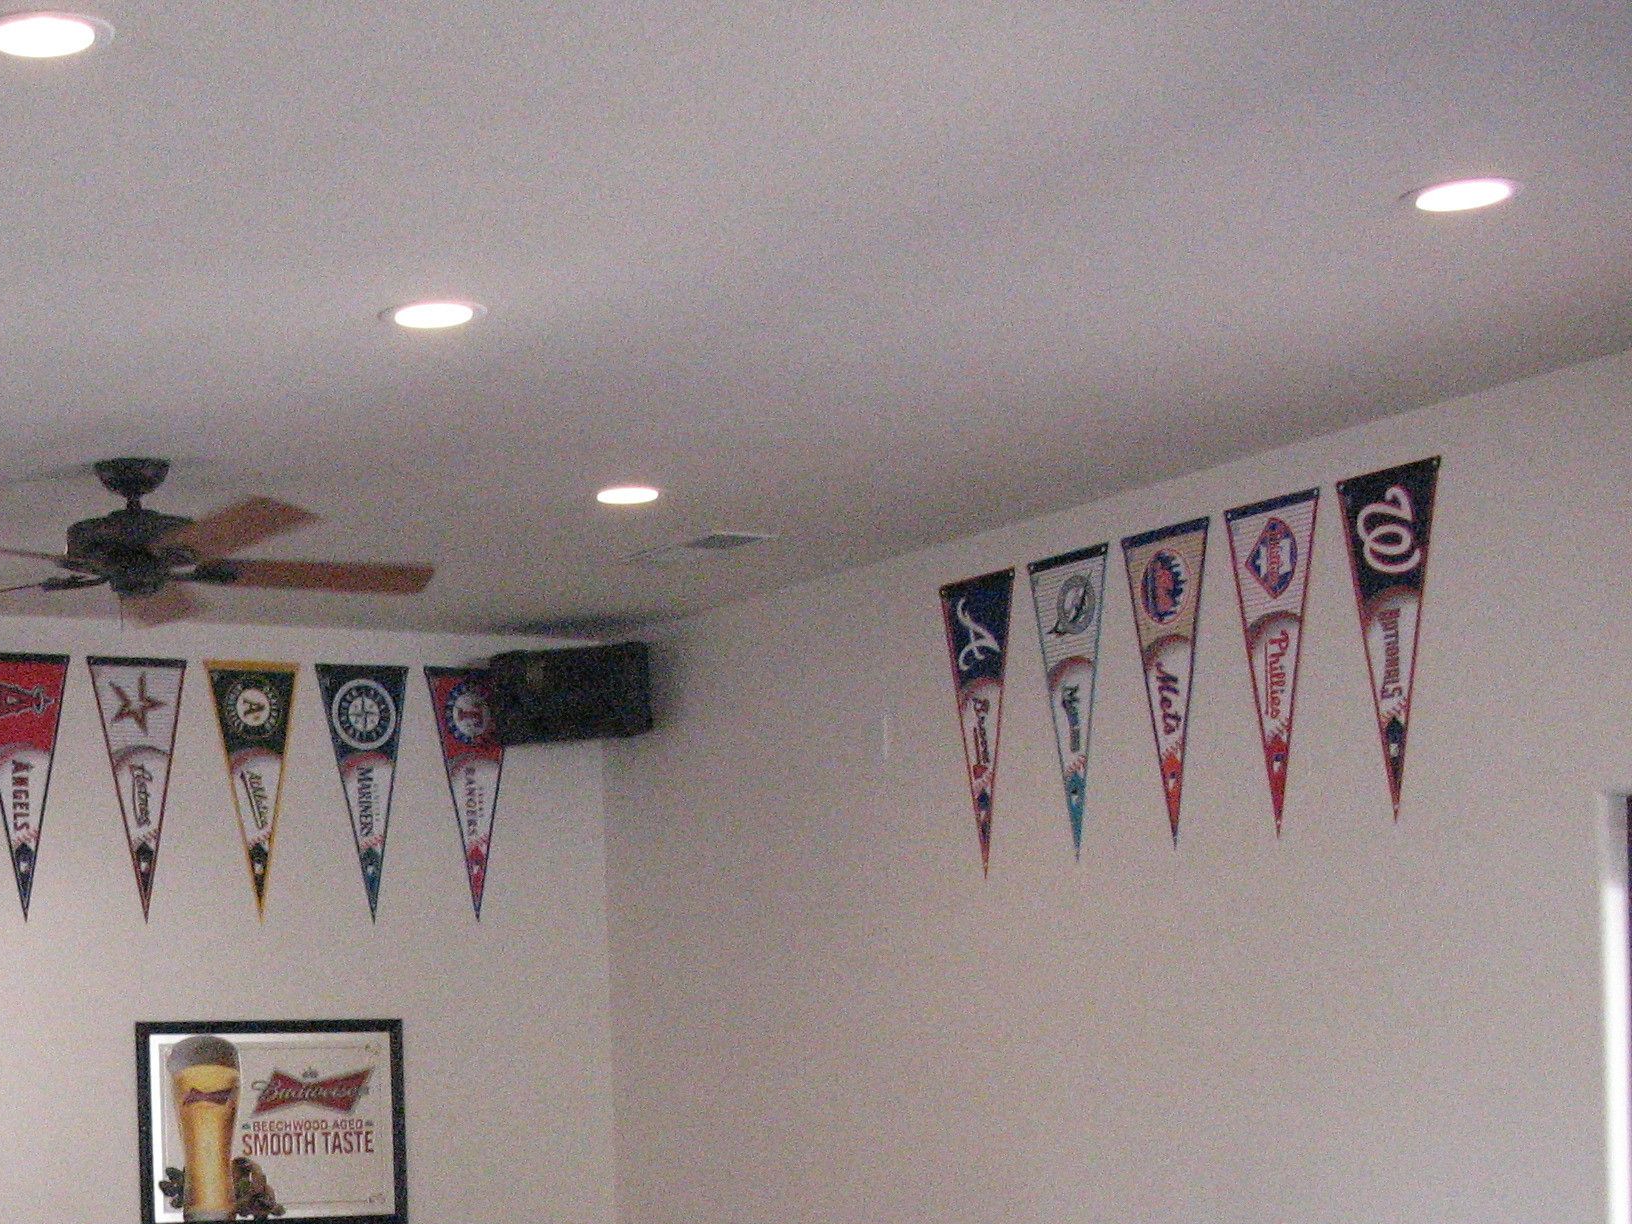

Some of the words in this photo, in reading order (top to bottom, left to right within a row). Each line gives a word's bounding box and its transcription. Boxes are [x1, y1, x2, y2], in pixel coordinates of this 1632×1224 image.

[1266, 629, 1289, 719] Phillies
[1378, 608, 1403, 700] NATIONALS
[1156, 656, 1183, 735] Mets
[11, 759, 34, 832] ANGELS
[356, 767, 374, 837] MARINERS
[465, 767, 477, 836] RANGERS
[241, 1132, 316, 1156] SMOOTH
[321, 1130, 375, 1155] TASTE
[252, 1119, 328, 1132] BEECHWOOD
[332, 1118, 364, 1130] AGED
